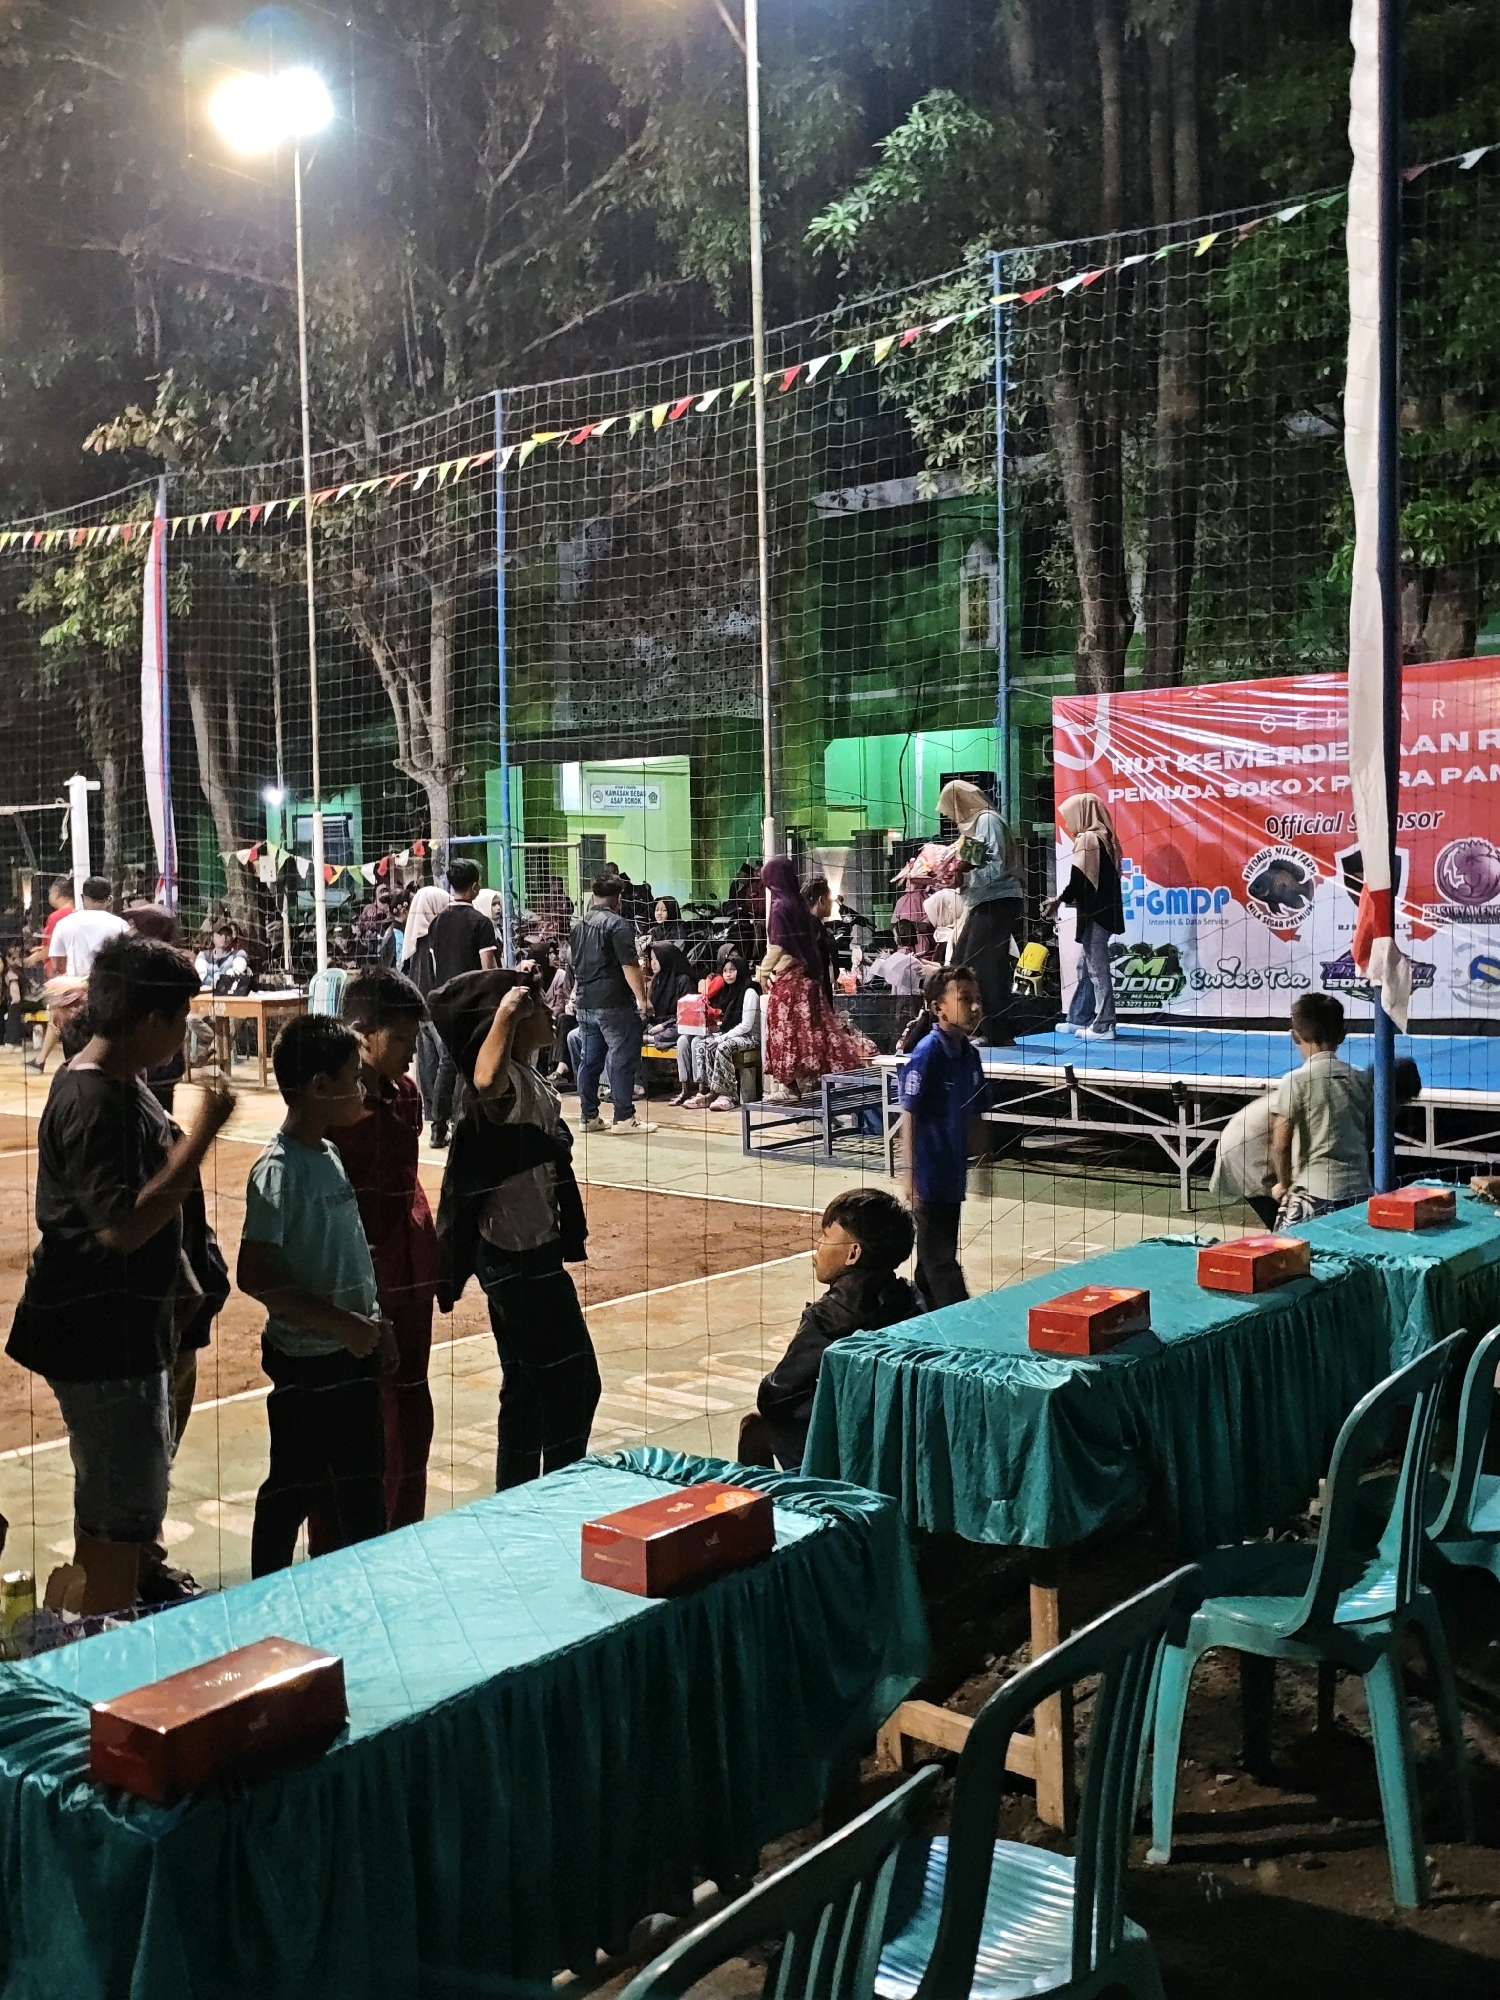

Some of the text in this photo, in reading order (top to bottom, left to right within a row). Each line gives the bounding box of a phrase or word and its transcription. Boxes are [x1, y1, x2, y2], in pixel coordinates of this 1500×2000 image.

[1112, 756, 1169, 775] HUT
[1177, 731, 1469, 773] KEMERDEAN
[1108, 784, 1220, 804] PEMUDA
[1223, 778, 1302, 798] SOKO
[1307, 776, 1326, 793] X
[1265, 812, 1344, 839] Official
[1243, 846, 1317, 880] FIRDAUS NILA FARM
[1146, 887, 1230, 916] GMDP
[1148, 918, 1176, 926] Internet
[1203, 917, 1230, 926] Service
[1248, 903, 1315, 928] NILA SEGAR PREMIUM
[1111, 977, 1175, 992] UDIO
[1189, 966, 1263, 991] Sweet
[1263, 966, 1312, 990] Tea
